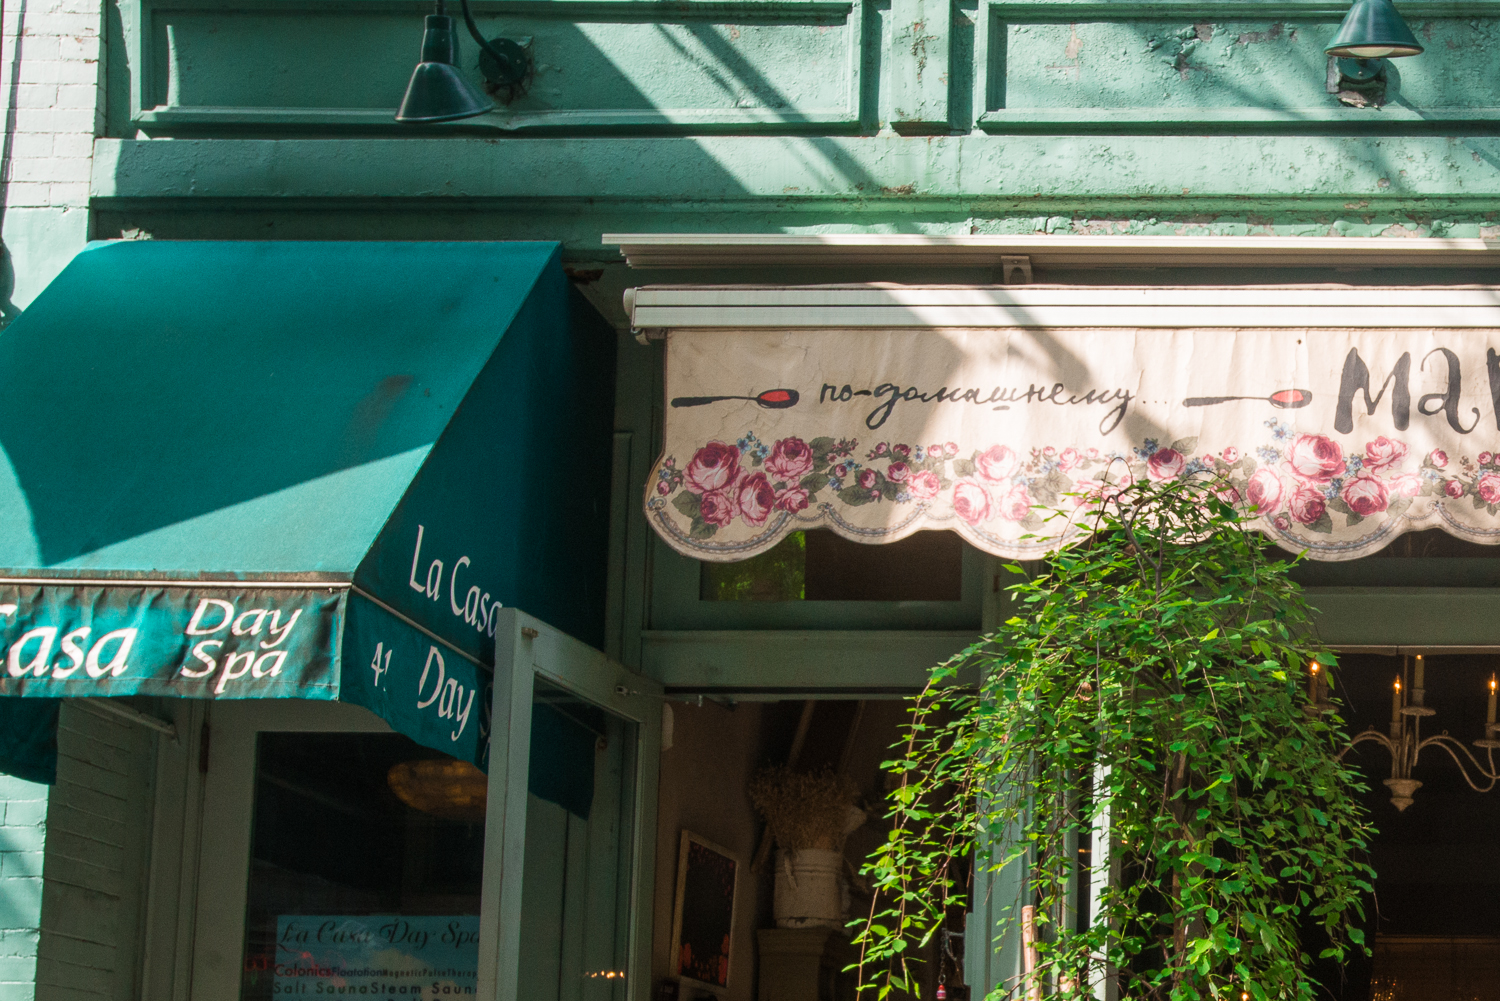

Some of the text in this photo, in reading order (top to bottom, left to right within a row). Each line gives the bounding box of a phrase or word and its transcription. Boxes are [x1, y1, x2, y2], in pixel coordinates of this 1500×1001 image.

[408, 524, 444, 602] La
[0, 603, 138, 680] asa
[186, 598, 304, 649] Day
[181, 639, 289, 694] Spa
[417, 646, 476, 742] Day
[278, 922, 308, 950] La
[317, 921, 372, 945] Casa
[379, 919, 433, 950] Day
[274, 981, 305, 994] Salt
[431, 982, 477, 994] Saun
[275, 963, 332, 977] Colonics
